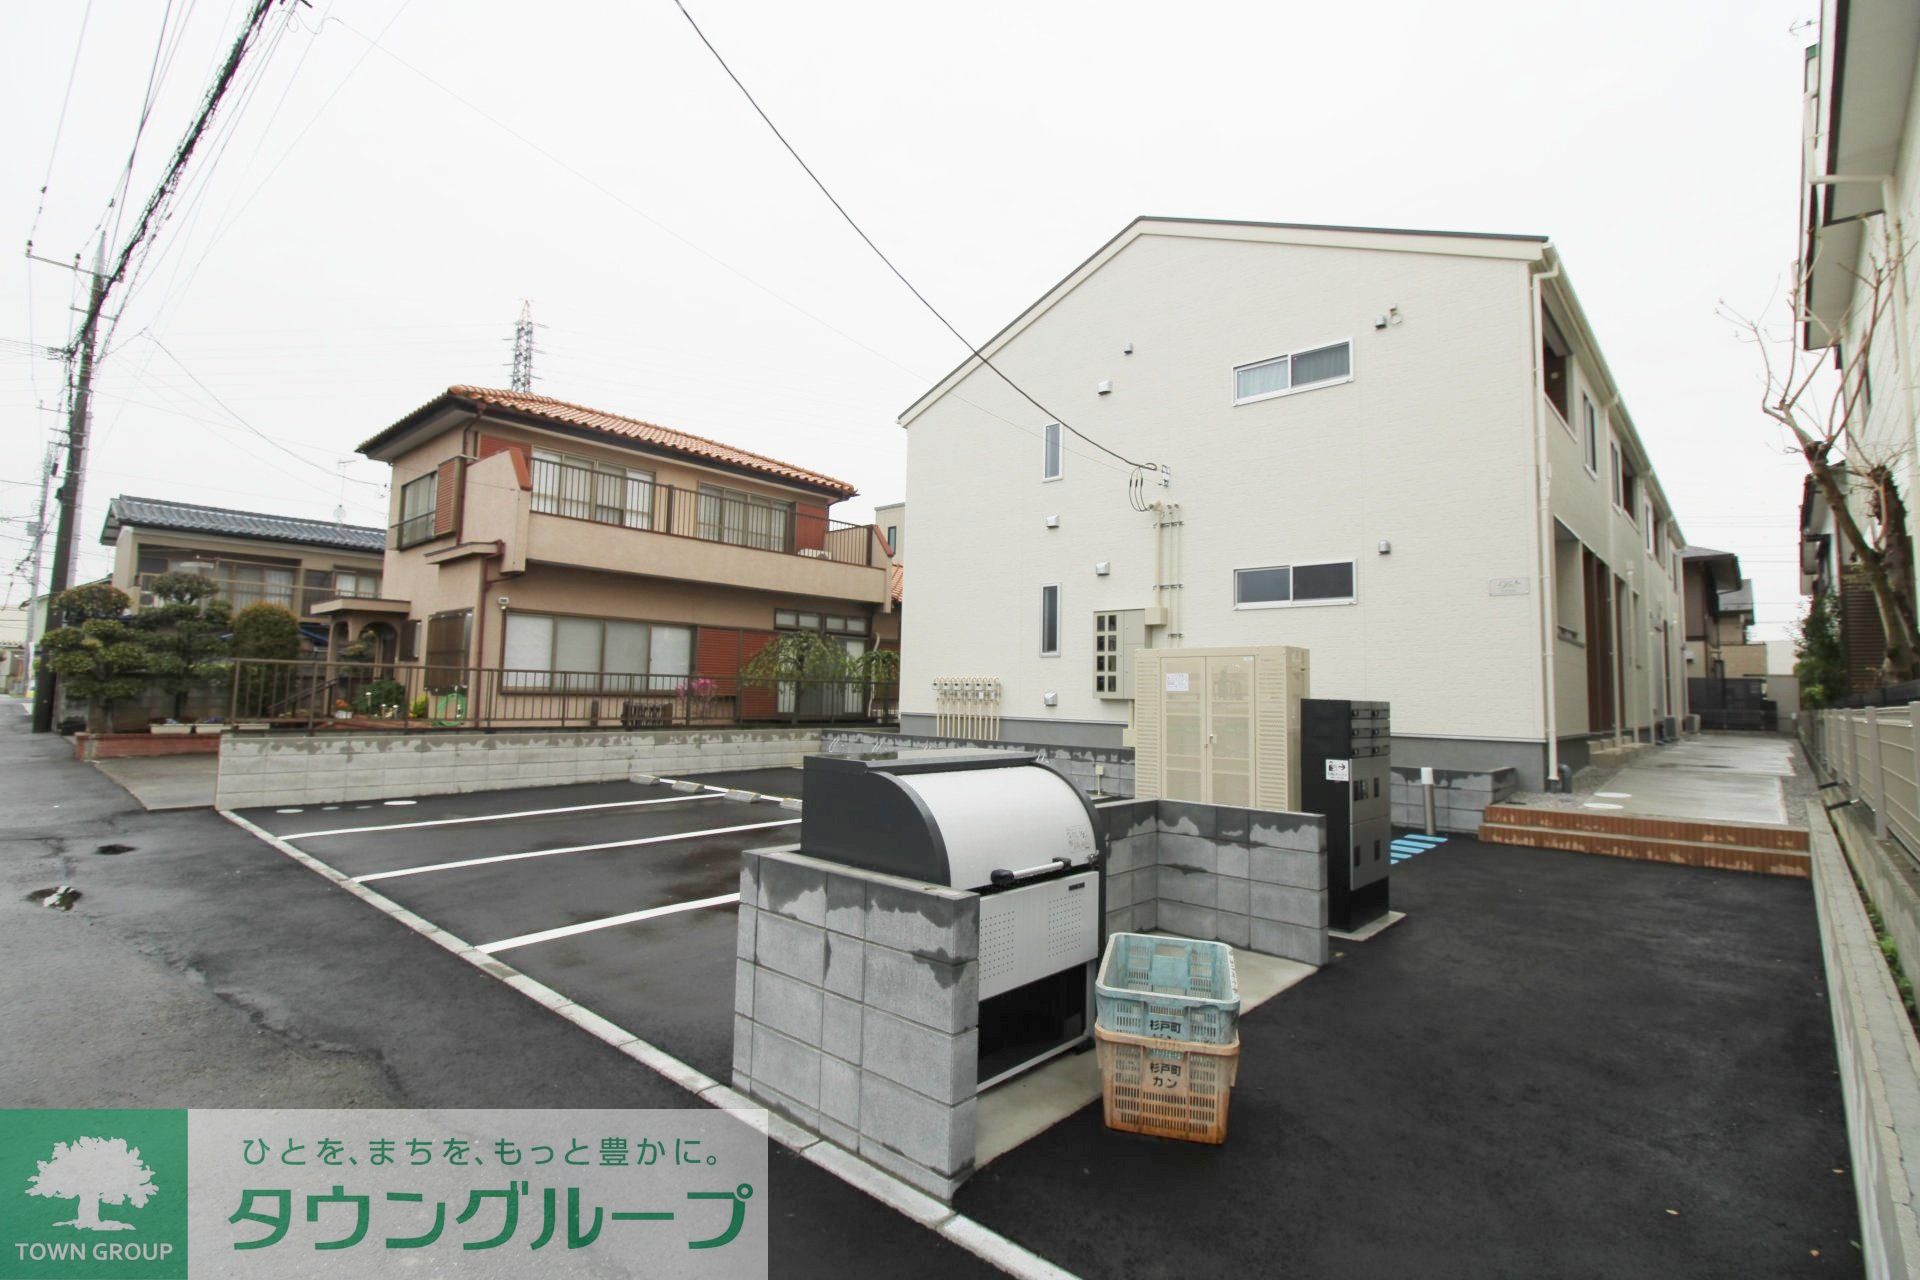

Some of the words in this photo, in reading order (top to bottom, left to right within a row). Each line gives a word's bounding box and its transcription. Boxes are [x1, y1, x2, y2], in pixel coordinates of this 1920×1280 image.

[1150, 1020, 1181, 1034] 杉戸町
[1150, 1062, 1181, 1077] 杉戸町
[1152, 1075, 1177, 1089] カン
